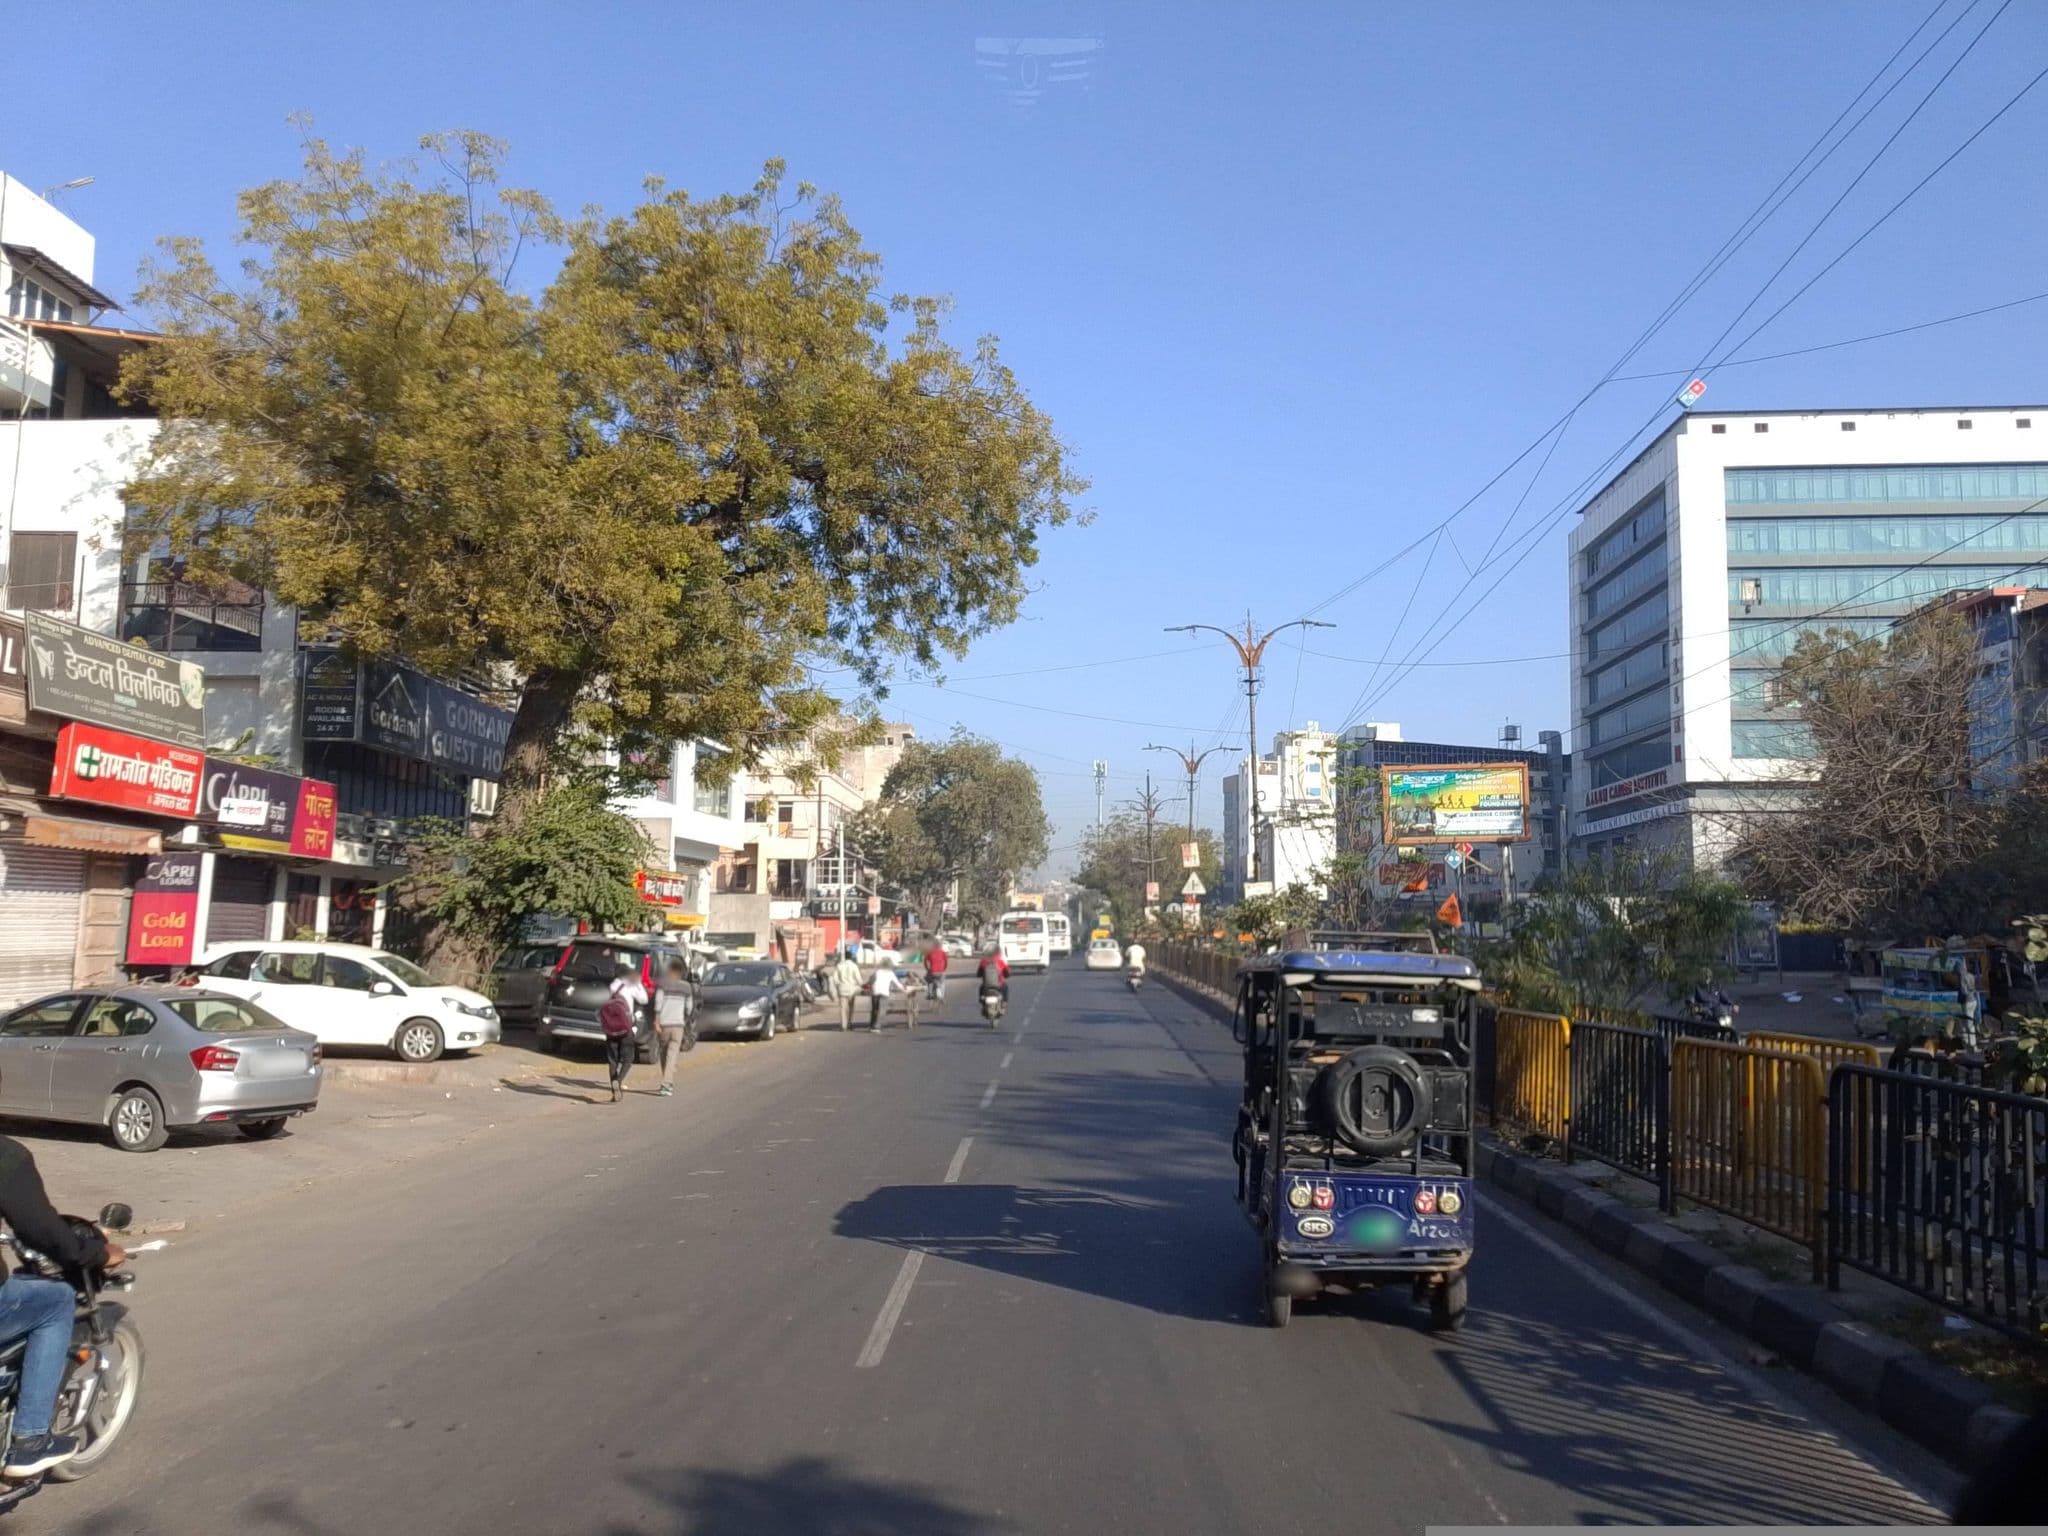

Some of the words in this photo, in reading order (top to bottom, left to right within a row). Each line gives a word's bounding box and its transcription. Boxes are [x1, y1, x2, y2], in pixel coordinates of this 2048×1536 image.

[83, 634, 121, 654] ADVANCED
[63, 641, 114, 690] डेन्टल
[306, 715, 353, 723] AVAILABLE
[314, 706, 347, 714] ROOMS
[369, 702, 422, 739] Gorband
[432, 730, 478, 766] GUEST
[146, 860, 196, 880] CAPRI
[160, 877, 195, 886] LOANS
[821, 902, 858, 913] SCOPS
[143, 911, 187, 930] Gold
[140, 932, 185, 950] Loan
[1303, 1222, 1329, 1233] SKS
